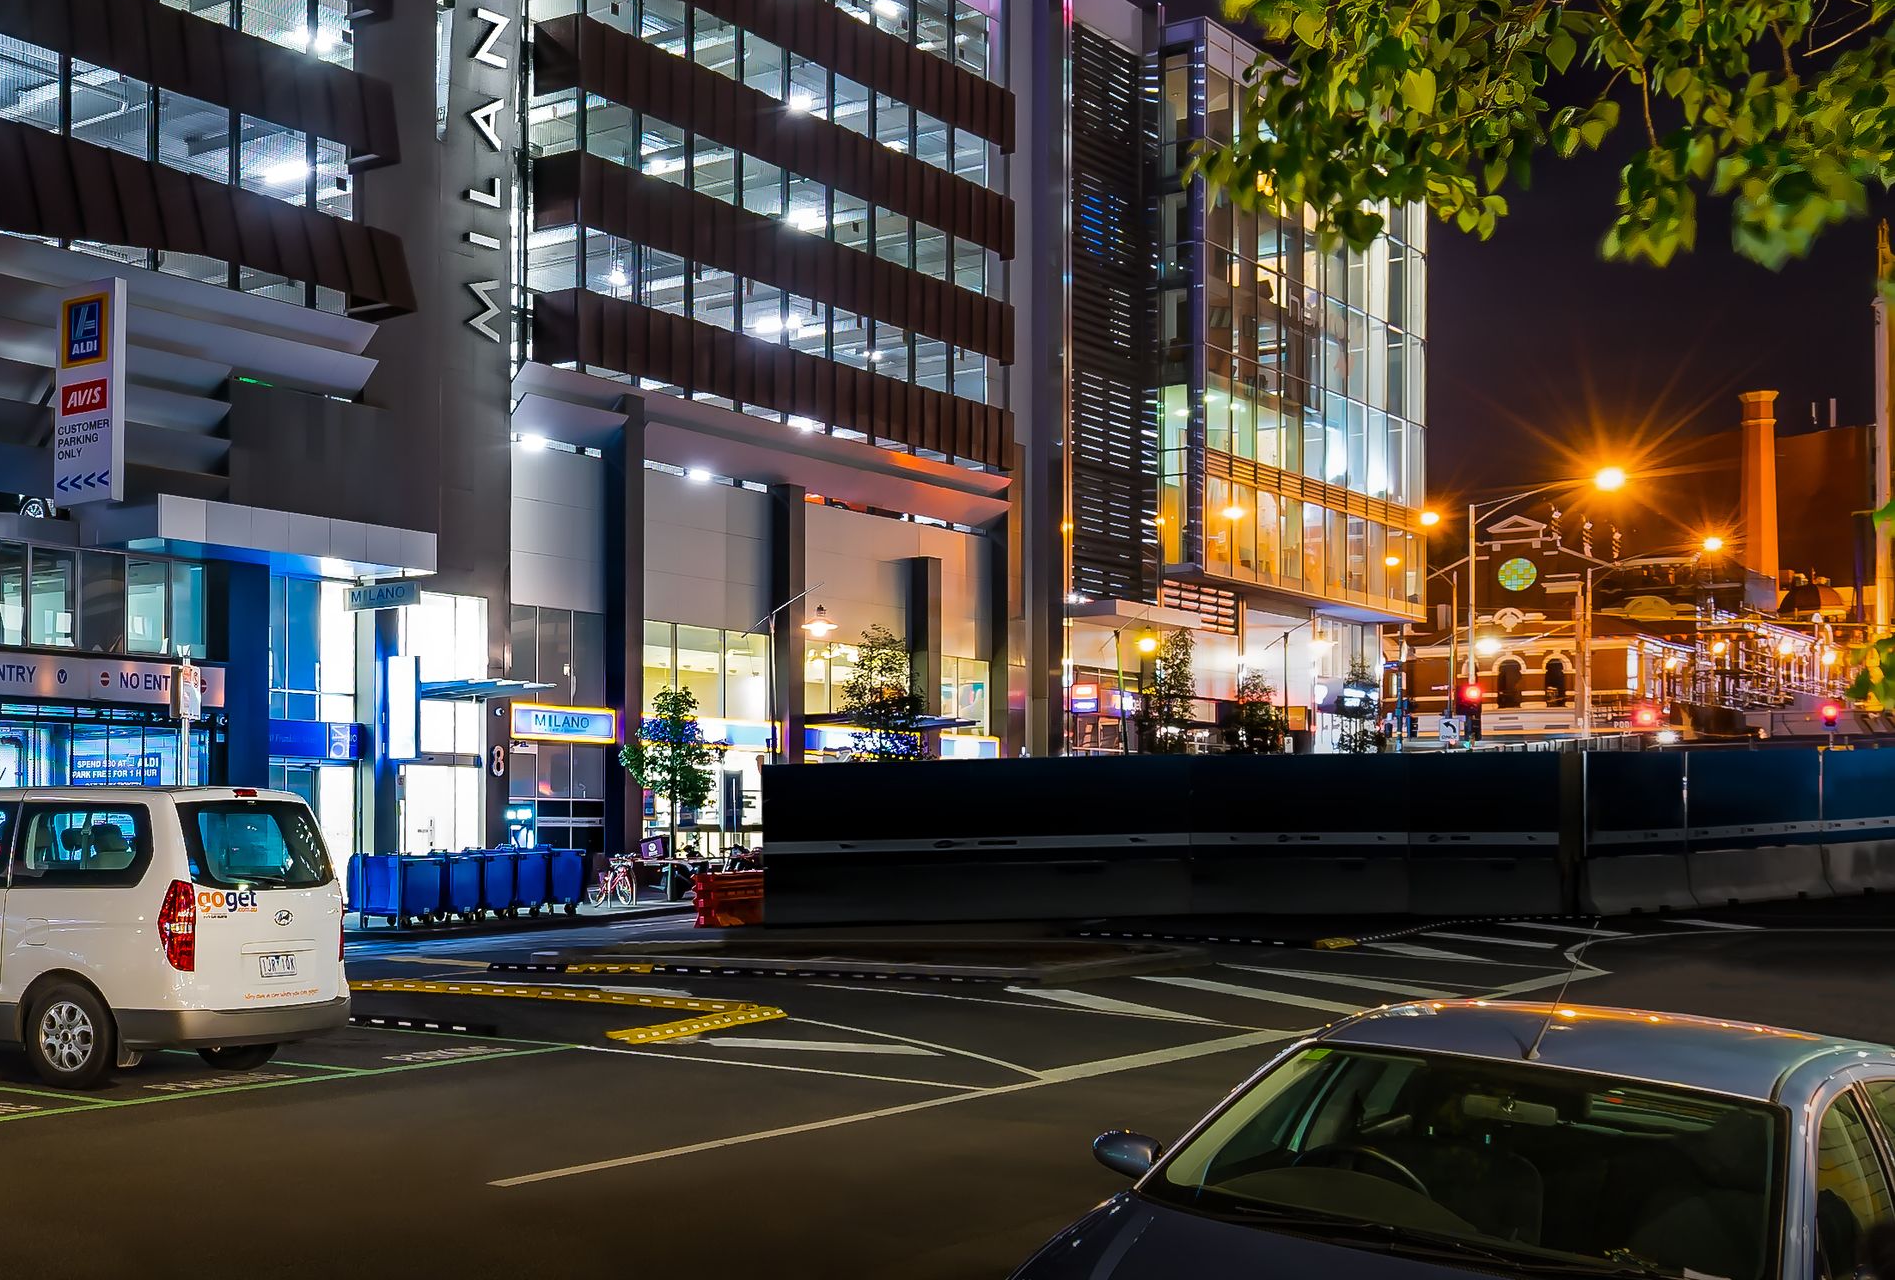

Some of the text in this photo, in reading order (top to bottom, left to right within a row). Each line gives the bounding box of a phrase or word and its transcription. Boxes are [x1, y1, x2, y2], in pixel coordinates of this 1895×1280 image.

[71, 339, 98, 356] ALDI
[66, 386, 100, 409] AVIS
[57, 418, 110, 436] CUSTOMER
[57, 432, 99, 449] PARKING
[57, 447, 83, 461] ONLY
[350, 586, 406, 603] MILANO
[119, 671, 140, 690] NO
[144, 673, 171, 692] ENT
[534, 713, 590, 729] MILANO
[77, 760, 102, 769] SPEND
[117, 759, 126, 767] AT
[492, 745, 505, 777] 8
[72, 770, 91, 779] PARK
[92, 769, 111, 778] FREE
[112, 769, 128, 778] FOR
[129, 768, 134, 777] 1
[197, 890, 258, 913] goget
